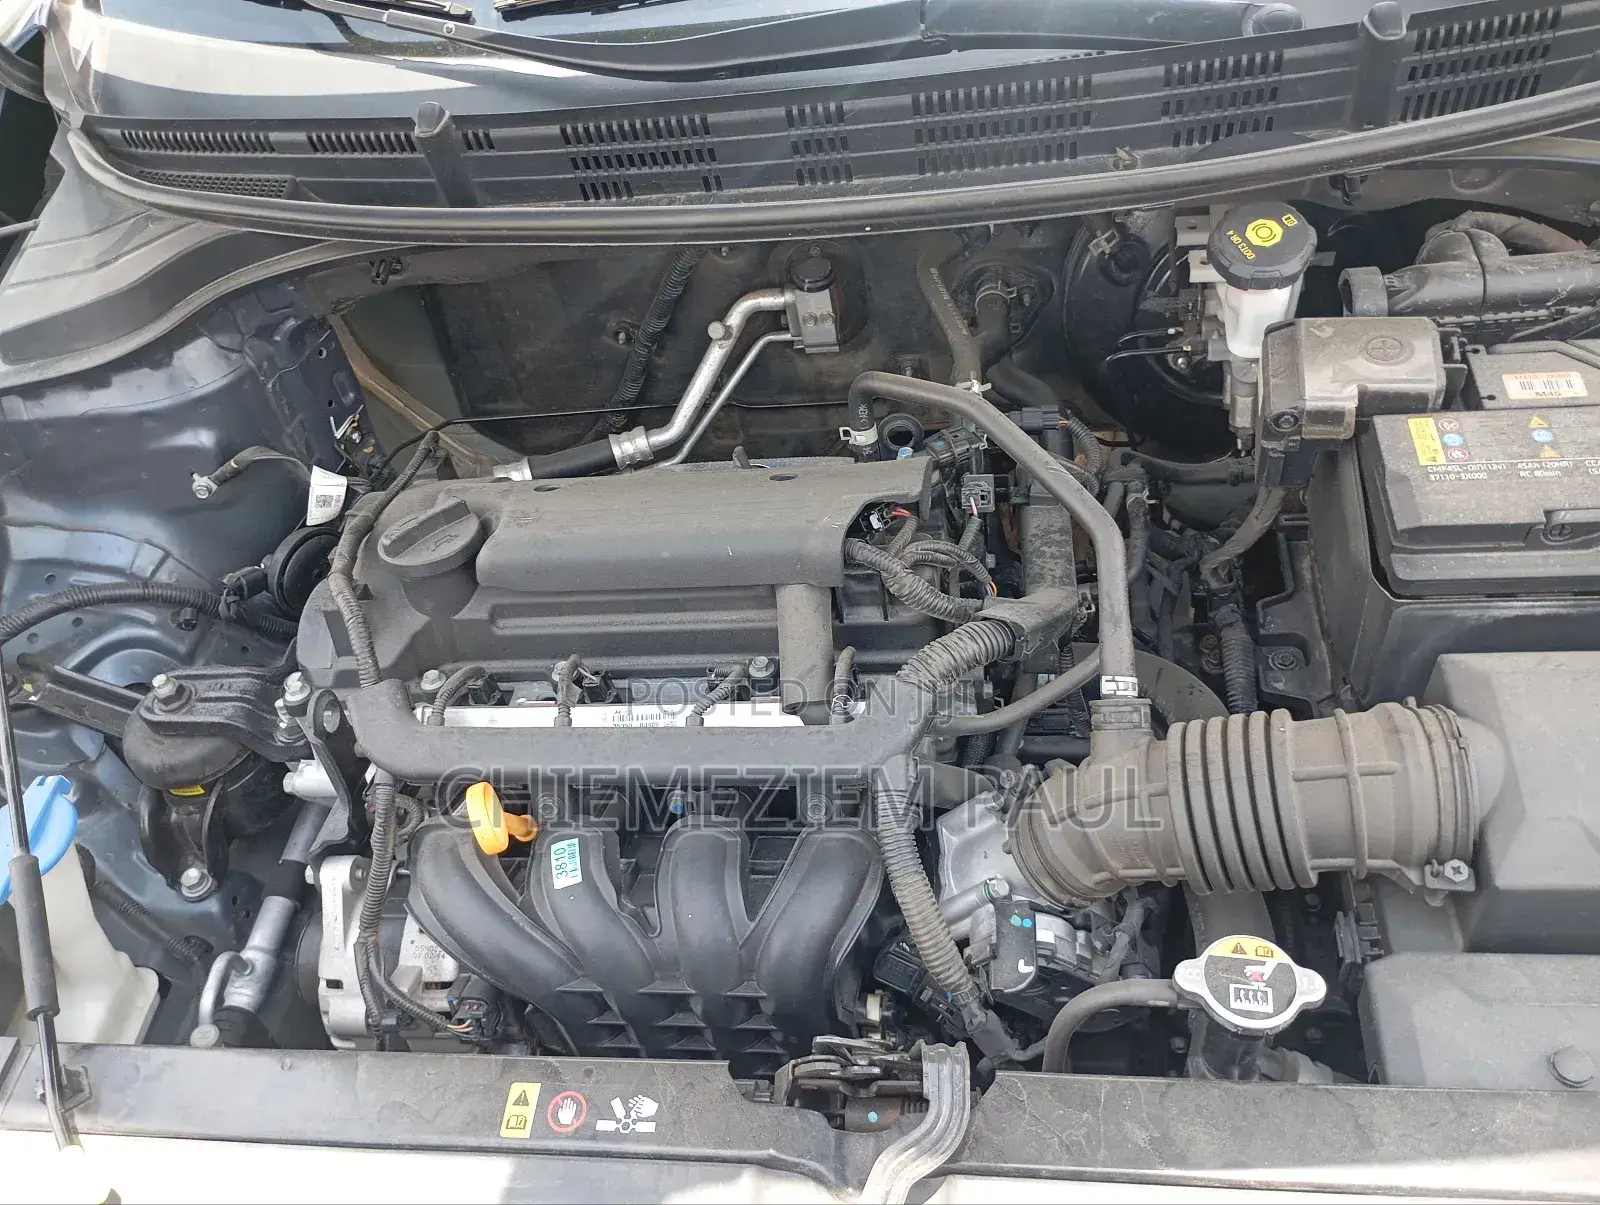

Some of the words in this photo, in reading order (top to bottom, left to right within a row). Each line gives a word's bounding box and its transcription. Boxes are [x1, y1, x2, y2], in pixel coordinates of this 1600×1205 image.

[1230, 234, 1242, 245] OR
[1239, 243, 1256, 260] DOT3
[1517, 461, 1540, 469] 45Ah
[1542, 460, 1573, 468] (20HR)
[1519, 470, 1533, 478] RC
[1534, 469, 1562, 477] 80min
[555, 847, 567, 880] 3810
